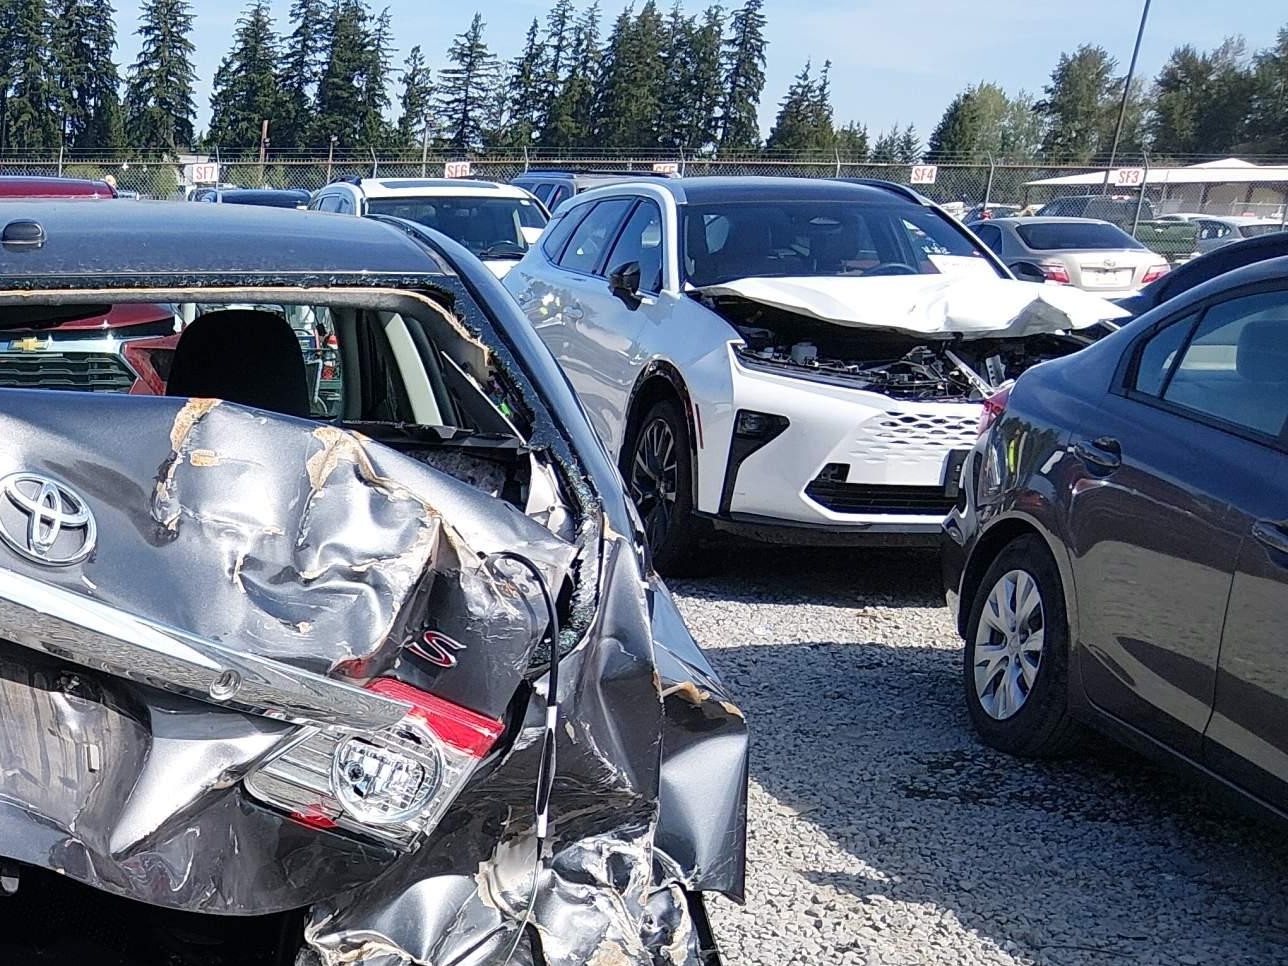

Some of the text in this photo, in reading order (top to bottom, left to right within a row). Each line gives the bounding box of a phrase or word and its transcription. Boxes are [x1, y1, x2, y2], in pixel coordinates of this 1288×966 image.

[196, 166, 215, 179] SF7
[447, 164, 468, 177] SF6
[913, 167, 935, 181] SF4
[1118, 170, 1140, 184] SF3
[406, 630, 467, 668] S
